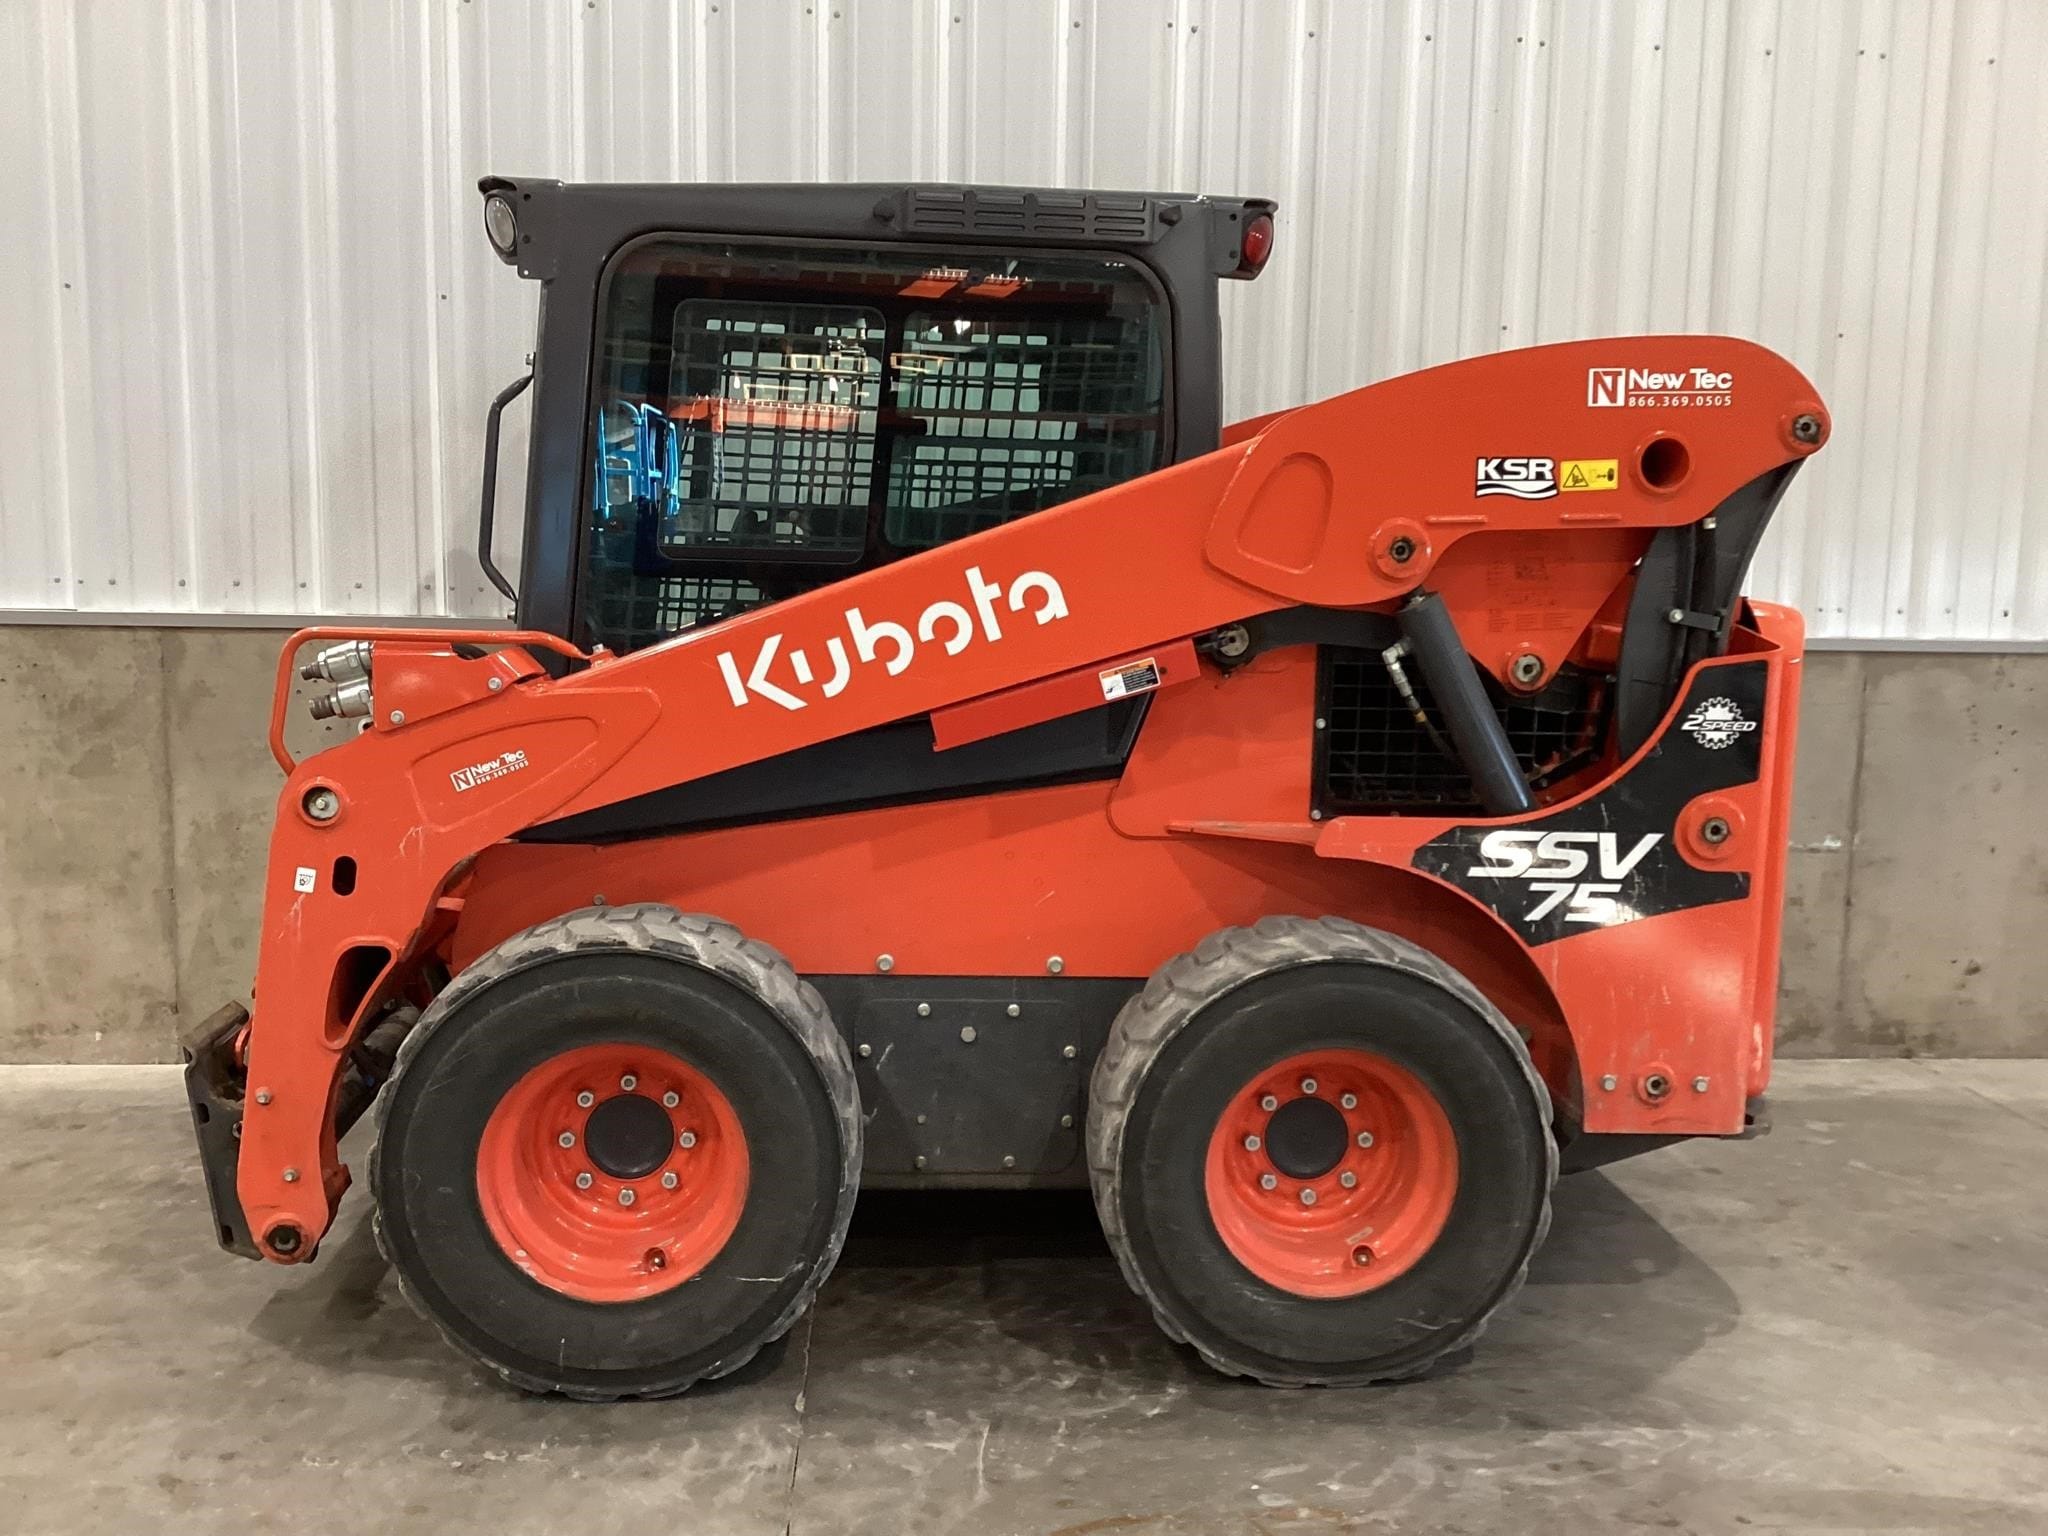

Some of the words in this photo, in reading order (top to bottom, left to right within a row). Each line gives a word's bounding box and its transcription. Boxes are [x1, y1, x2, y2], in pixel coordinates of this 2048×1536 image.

[1629, 368, 1686, 390] New
[1689, 368, 1733, 389] Tec
[1628, 396, 1732, 407] 866.369.0505
[1477, 458, 1554, 480] KSR
[716, 565, 1069, 711] Kubota
[470, 759, 500, 776] New
[500, 750, 525, 764] Tec
[1466, 830, 1665, 880] SSV
[1523, 882, 1623, 923] 75
